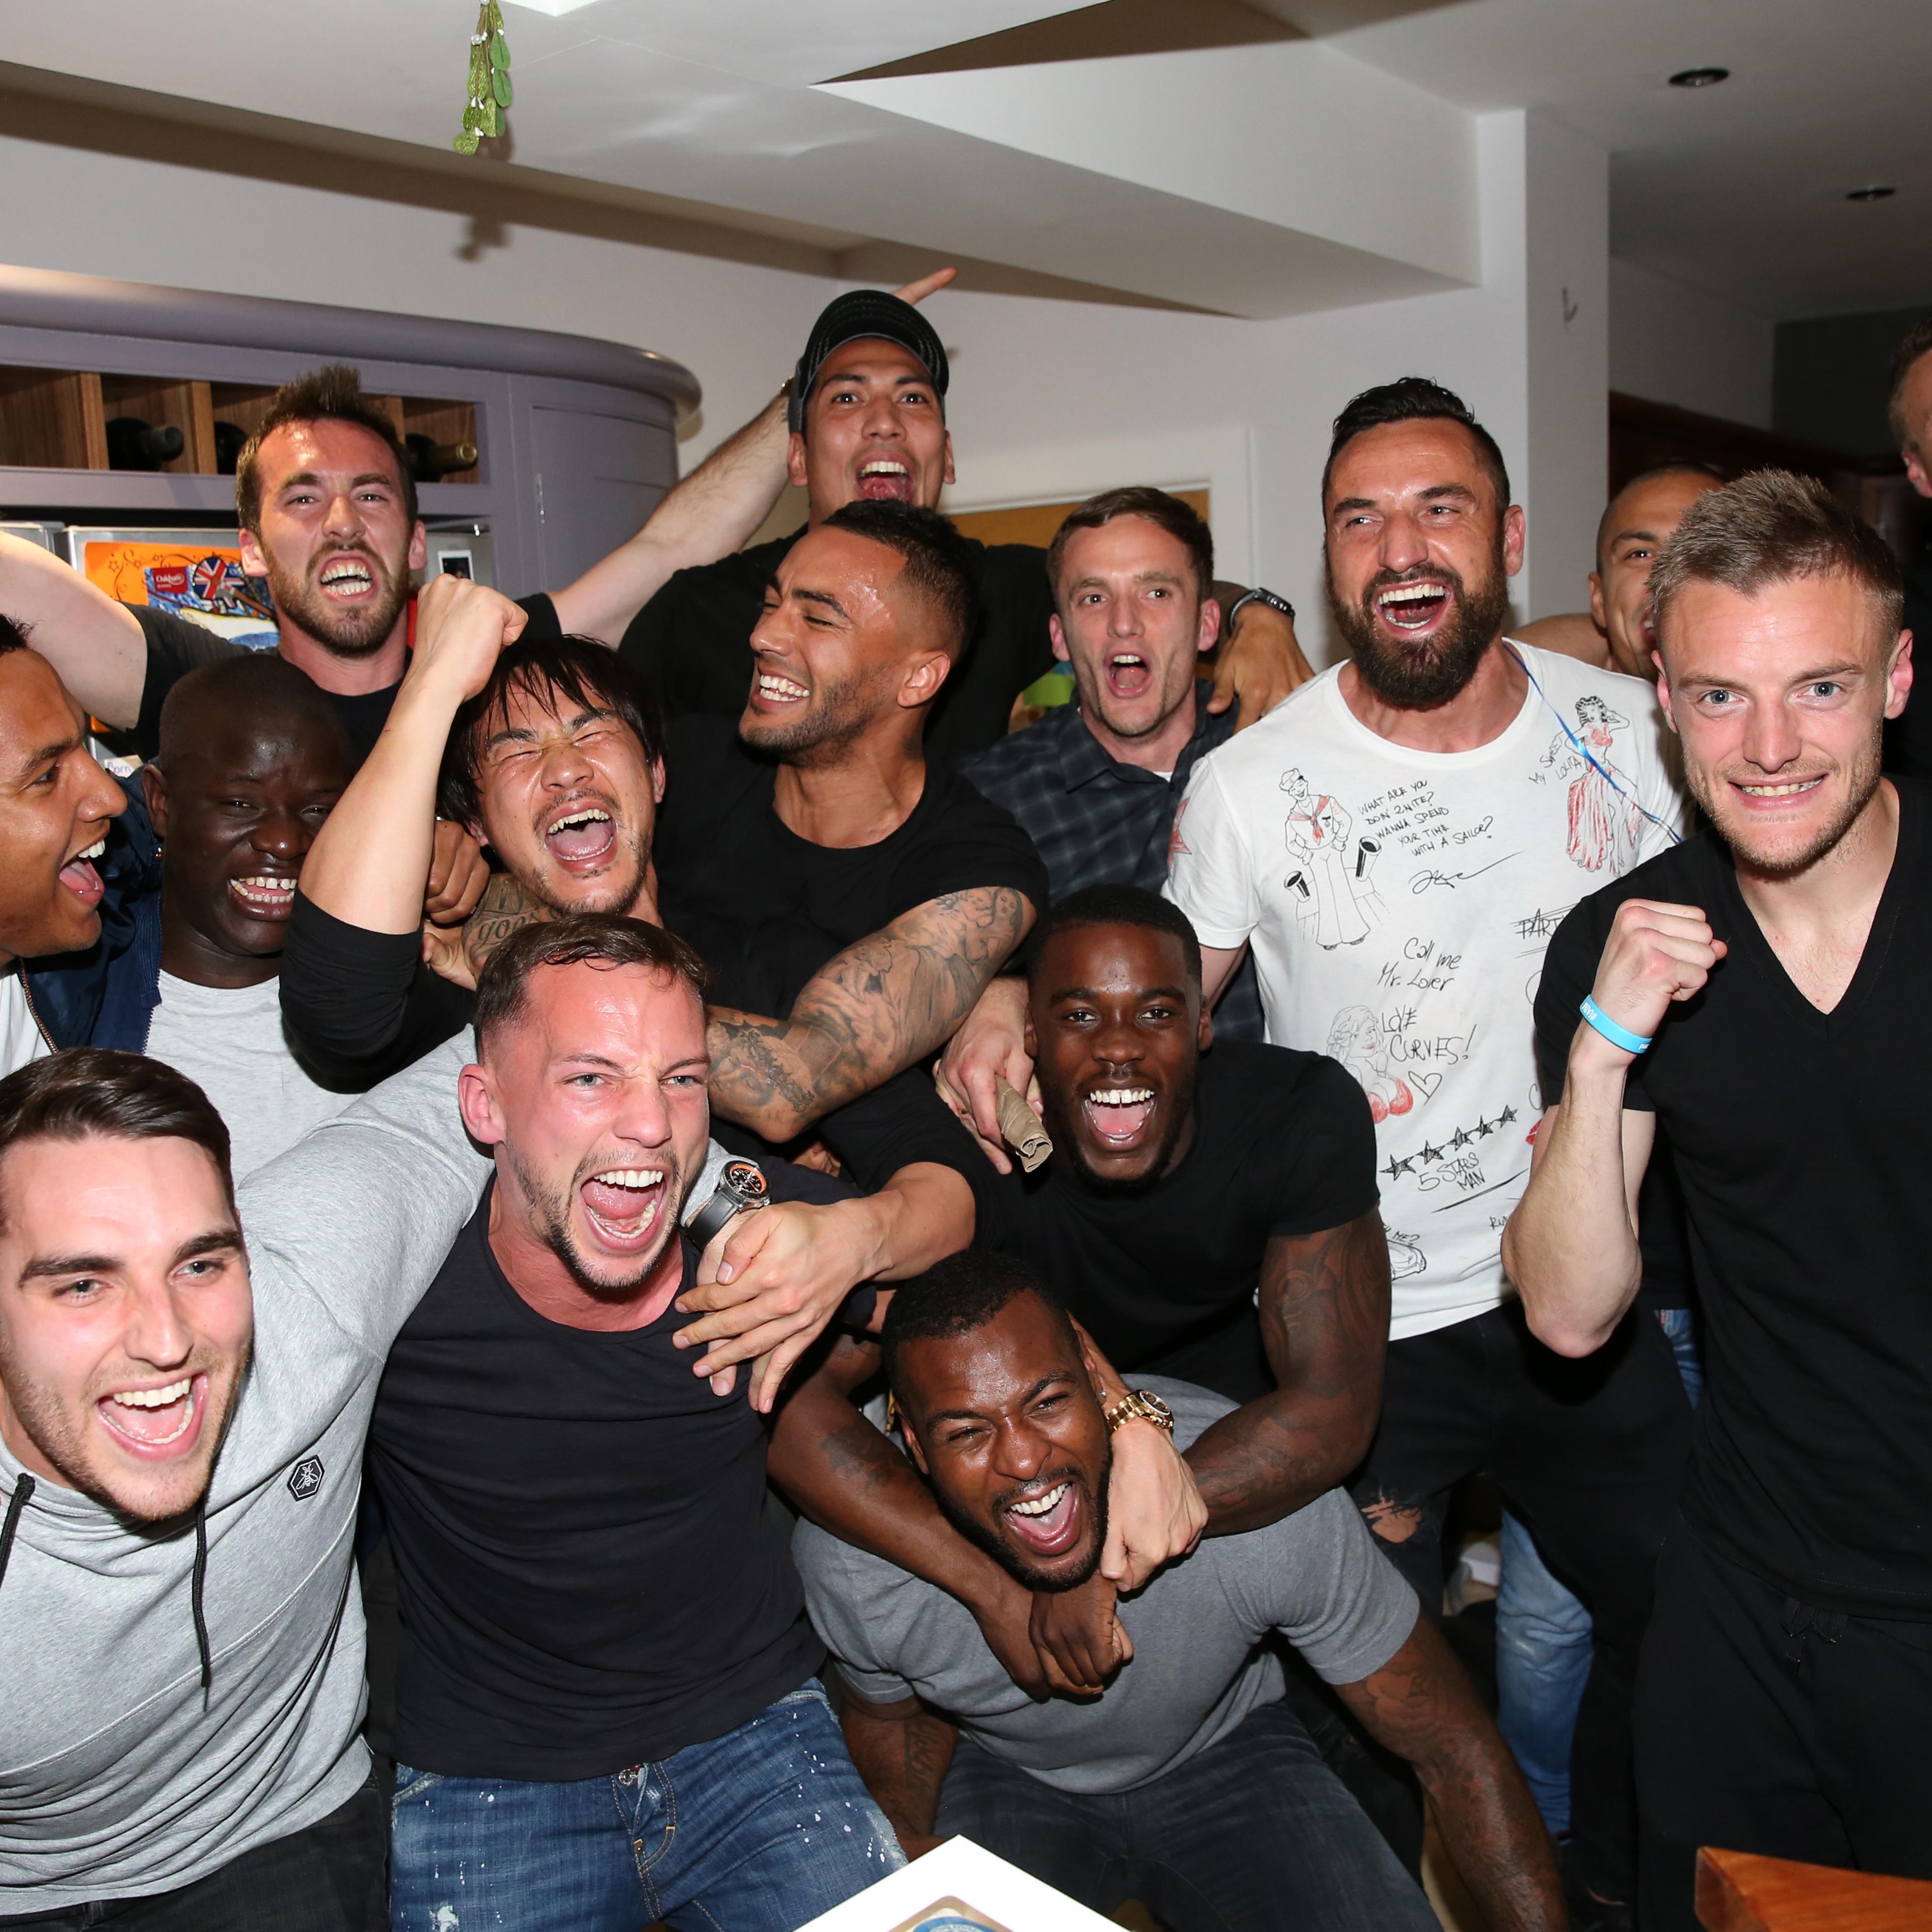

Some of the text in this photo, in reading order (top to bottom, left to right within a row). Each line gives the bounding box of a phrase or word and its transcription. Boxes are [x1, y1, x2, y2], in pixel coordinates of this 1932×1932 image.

[1556, 755, 1582, 779] LOLITA
[1358, 780, 1427, 815] WHAT ARE YOU
[1394, 791, 1434, 814] 2NITE?
[1375, 807, 1449, 839] WANNA SPEND
[1398, 824, 1449, 847] YOUR TIME
[1411, 815, 1493, 856] WITH A SAILOR?
[1515, 908, 1564, 940] PART
[1404, 937, 1462, 970] Call me
[1377, 961, 1455, 991] Mr. Lover
[1382, 1004, 1417, 1032] LOVE
[1390, 1024, 1477, 1065] CURVES!
[1417, 1152, 1479, 1191] 5 STARS
[1457, 1168, 1485, 1190] MAN
[1392, 1231, 1420, 1245] ME?
